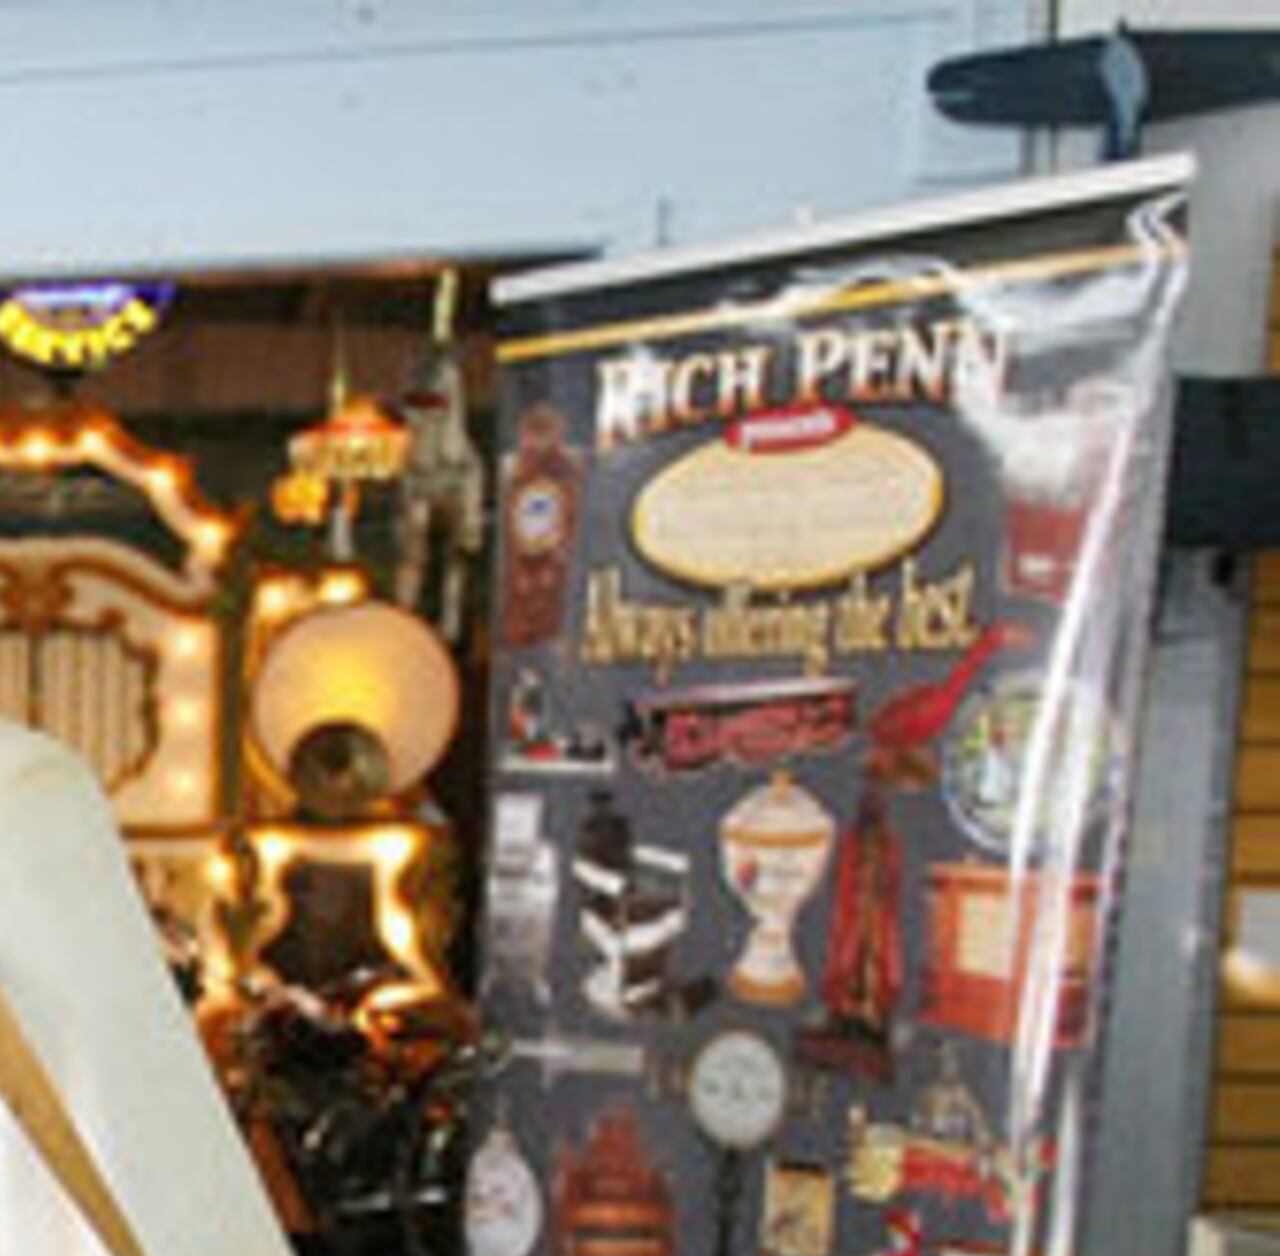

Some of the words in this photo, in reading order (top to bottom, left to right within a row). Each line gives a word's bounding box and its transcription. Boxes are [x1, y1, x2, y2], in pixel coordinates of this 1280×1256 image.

[593, 344, 774, 448] RICH
[795, 316, 1010, 407] PENN
[579, 565, 697, 686] Always
[704, 581, 831, 678] offering
[835, 573, 891, 649] the
